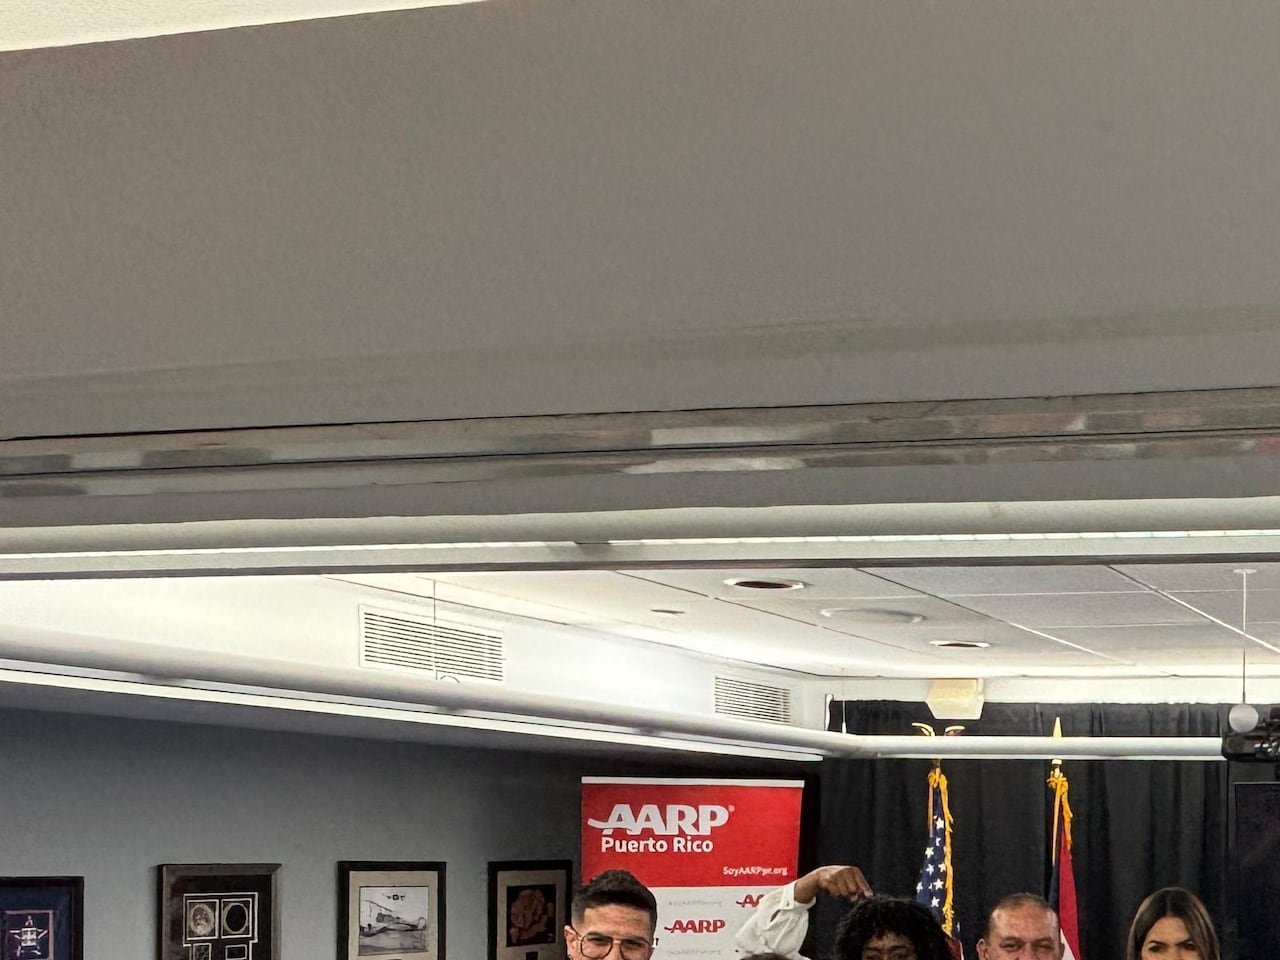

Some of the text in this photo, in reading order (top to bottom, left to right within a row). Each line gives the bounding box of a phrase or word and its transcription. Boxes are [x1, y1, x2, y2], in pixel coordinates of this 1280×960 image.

[588, 804, 729, 835] AARP
[601, 837, 713, 852] Puerto Rico
[664, 920, 725, 933] AARP
